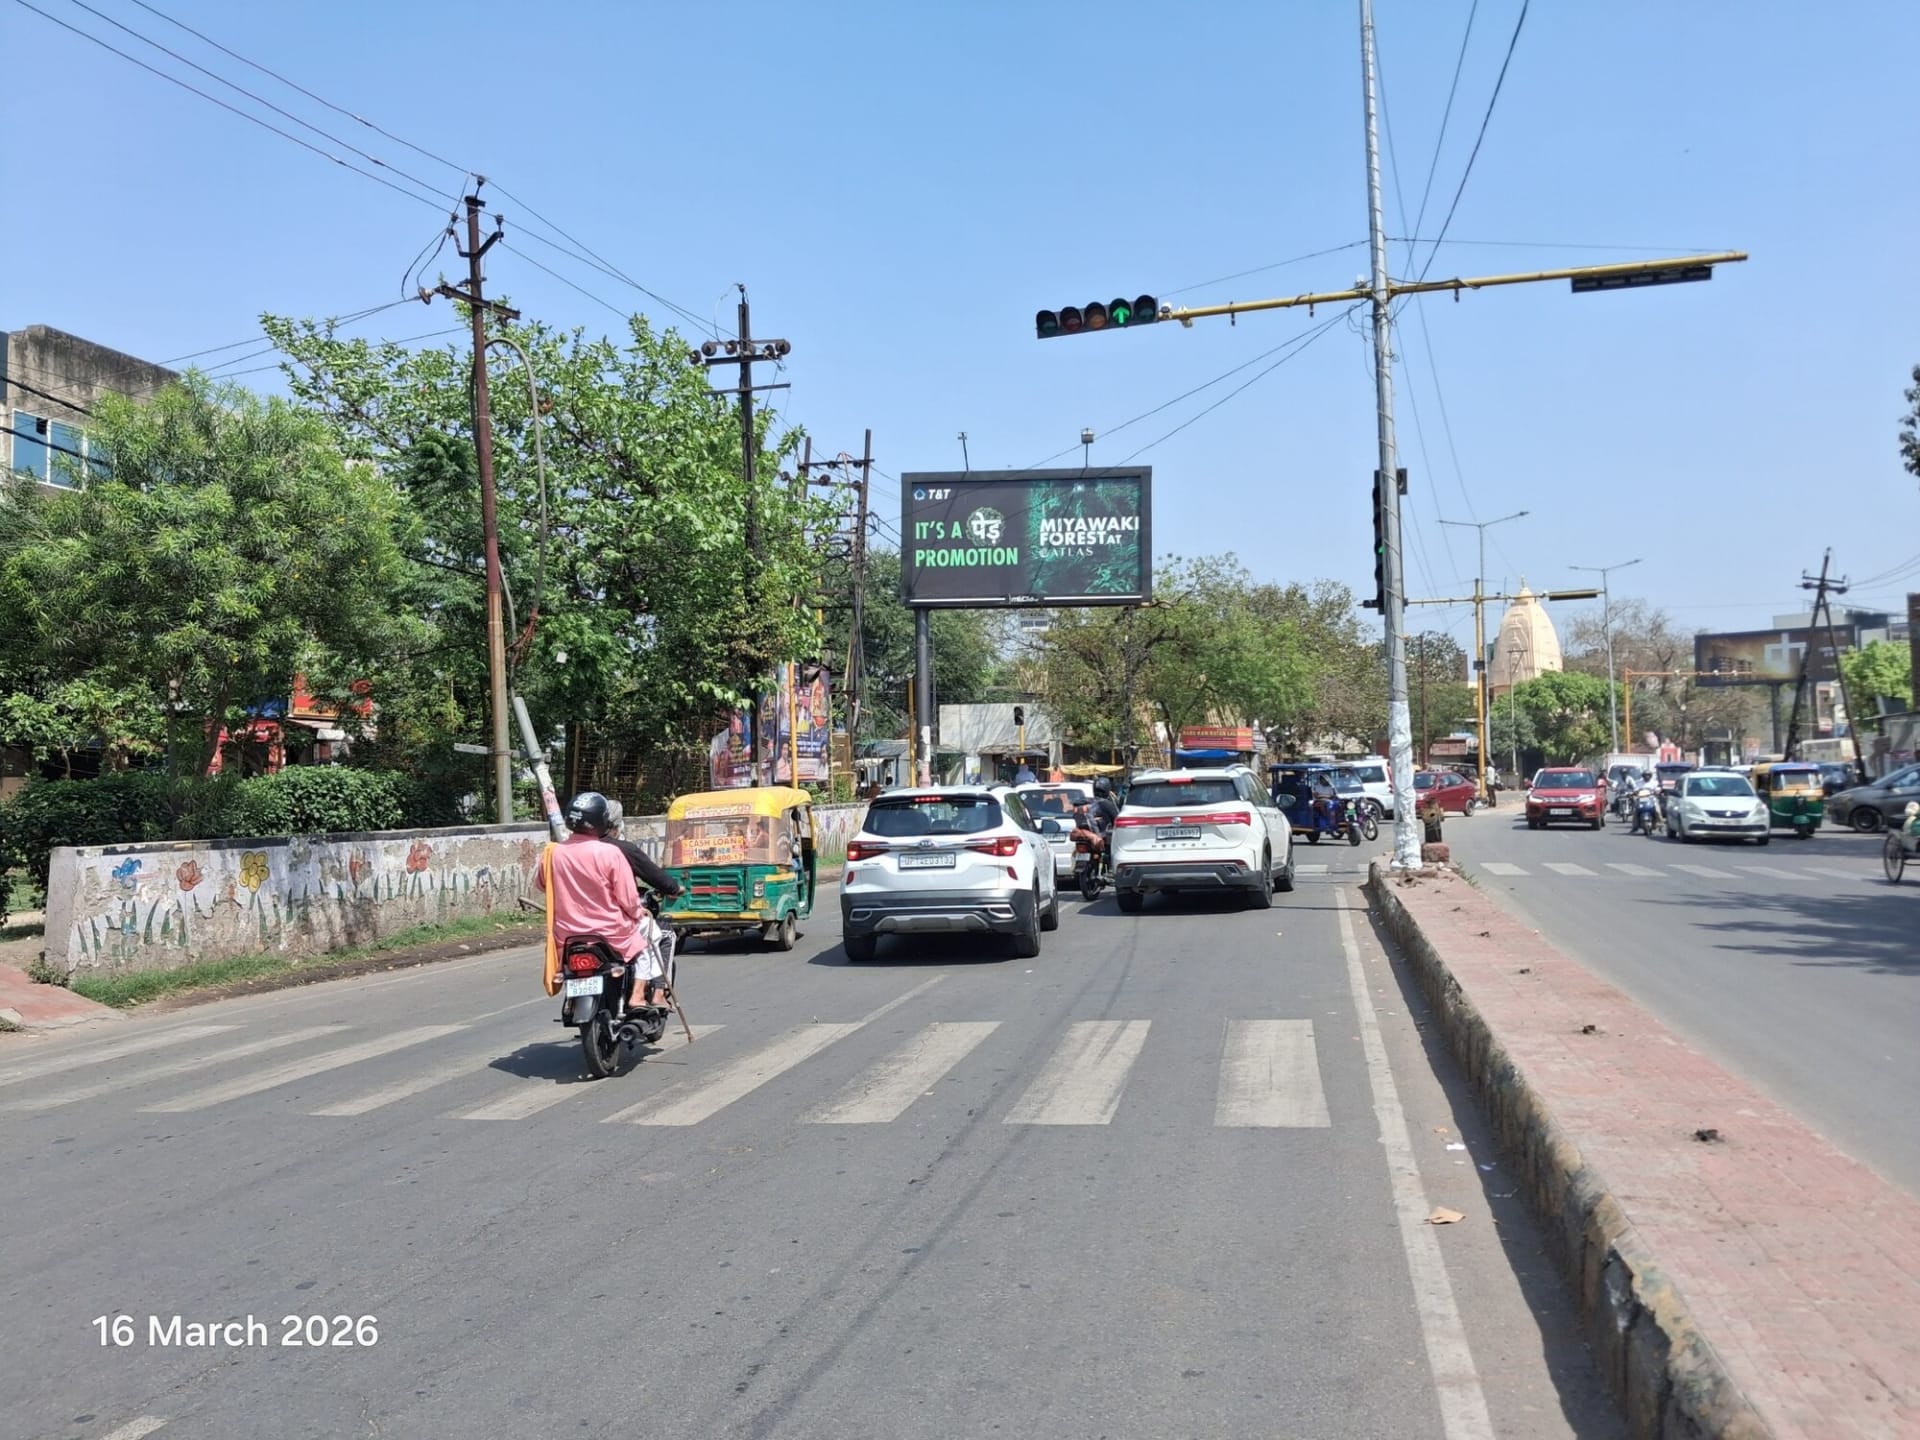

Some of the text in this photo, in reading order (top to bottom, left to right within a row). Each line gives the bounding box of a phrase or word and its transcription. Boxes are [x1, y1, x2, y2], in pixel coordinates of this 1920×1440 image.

[928, 489, 951, 500] T&T
[915, 512, 1002, 544] IT'S A पेड़
[1040, 516, 1139, 532] MIYAWAKI
[1040, 531, 1122, 546] FOREST AT
[915, 547, 1018, 567] PROMOTION
[688, 838, 737, 848] CASH LOAN
